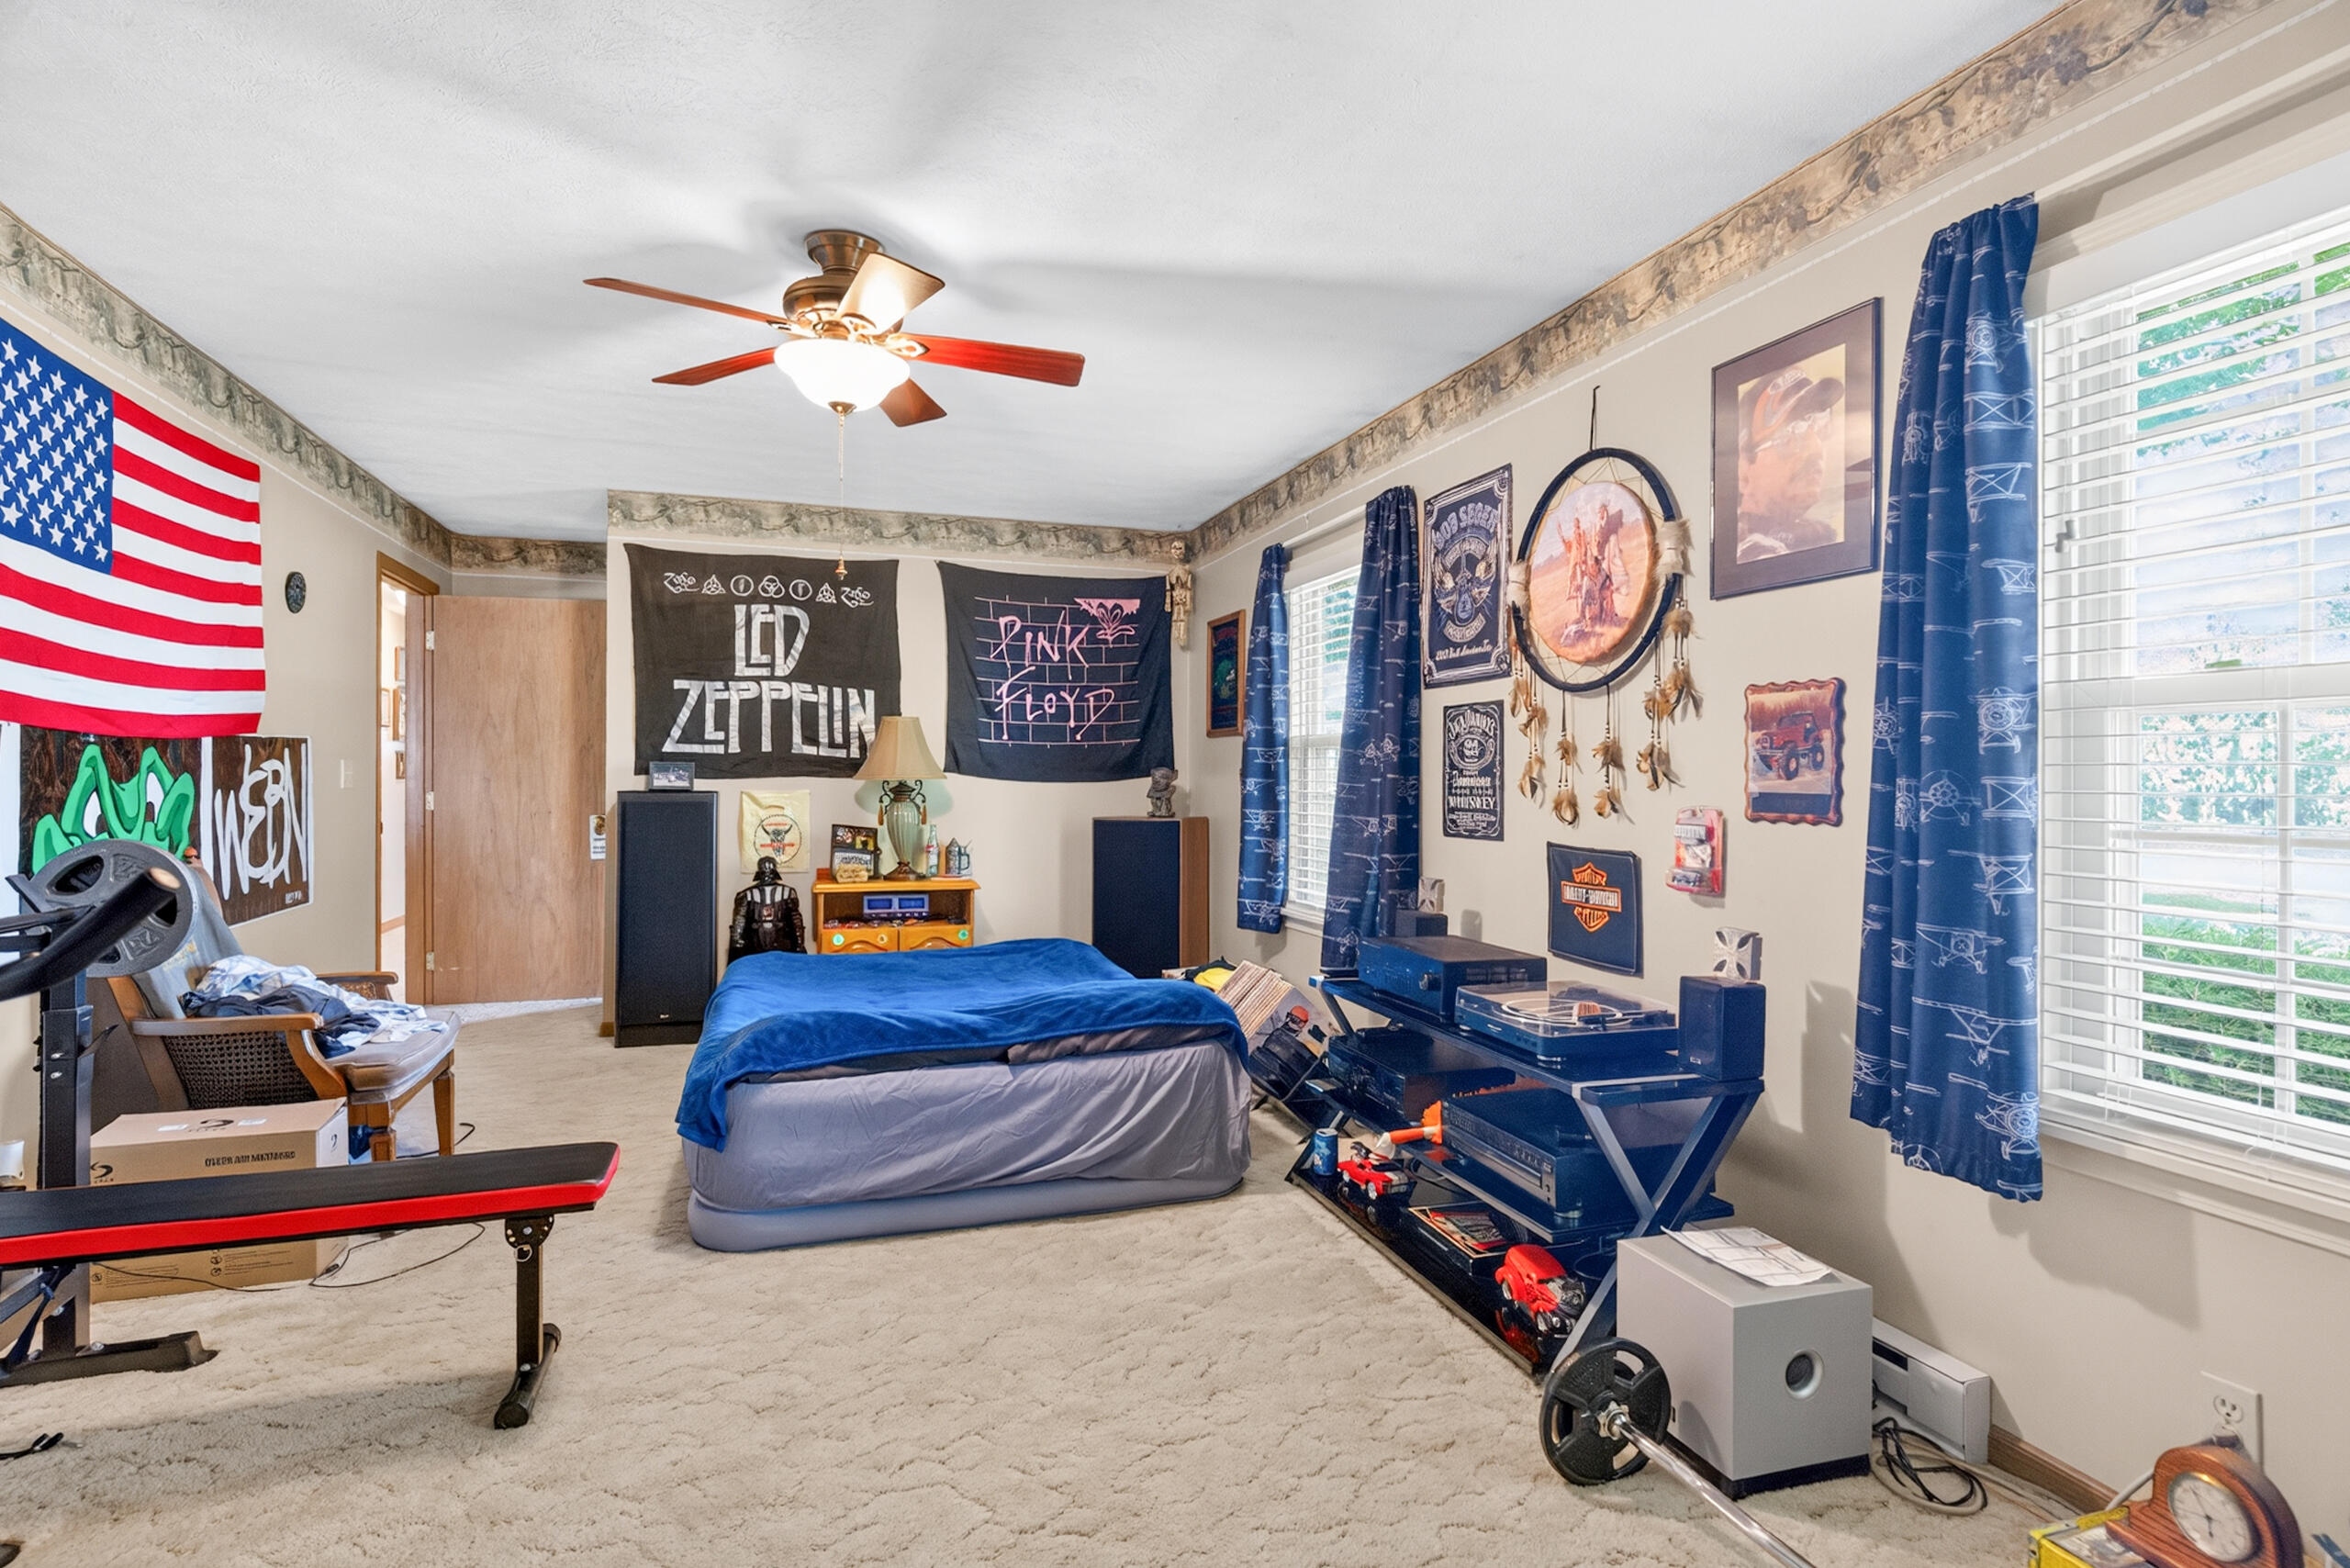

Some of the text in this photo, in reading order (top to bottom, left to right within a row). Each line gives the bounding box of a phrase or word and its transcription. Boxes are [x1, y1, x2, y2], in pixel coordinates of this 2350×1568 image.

[734, 604, 811, 677] LED
[990, 610, 1090, 680] PINK
[662, 679, 876, 759] ZEPPELIN
[994, 666, 1115, 741] FLOYD
